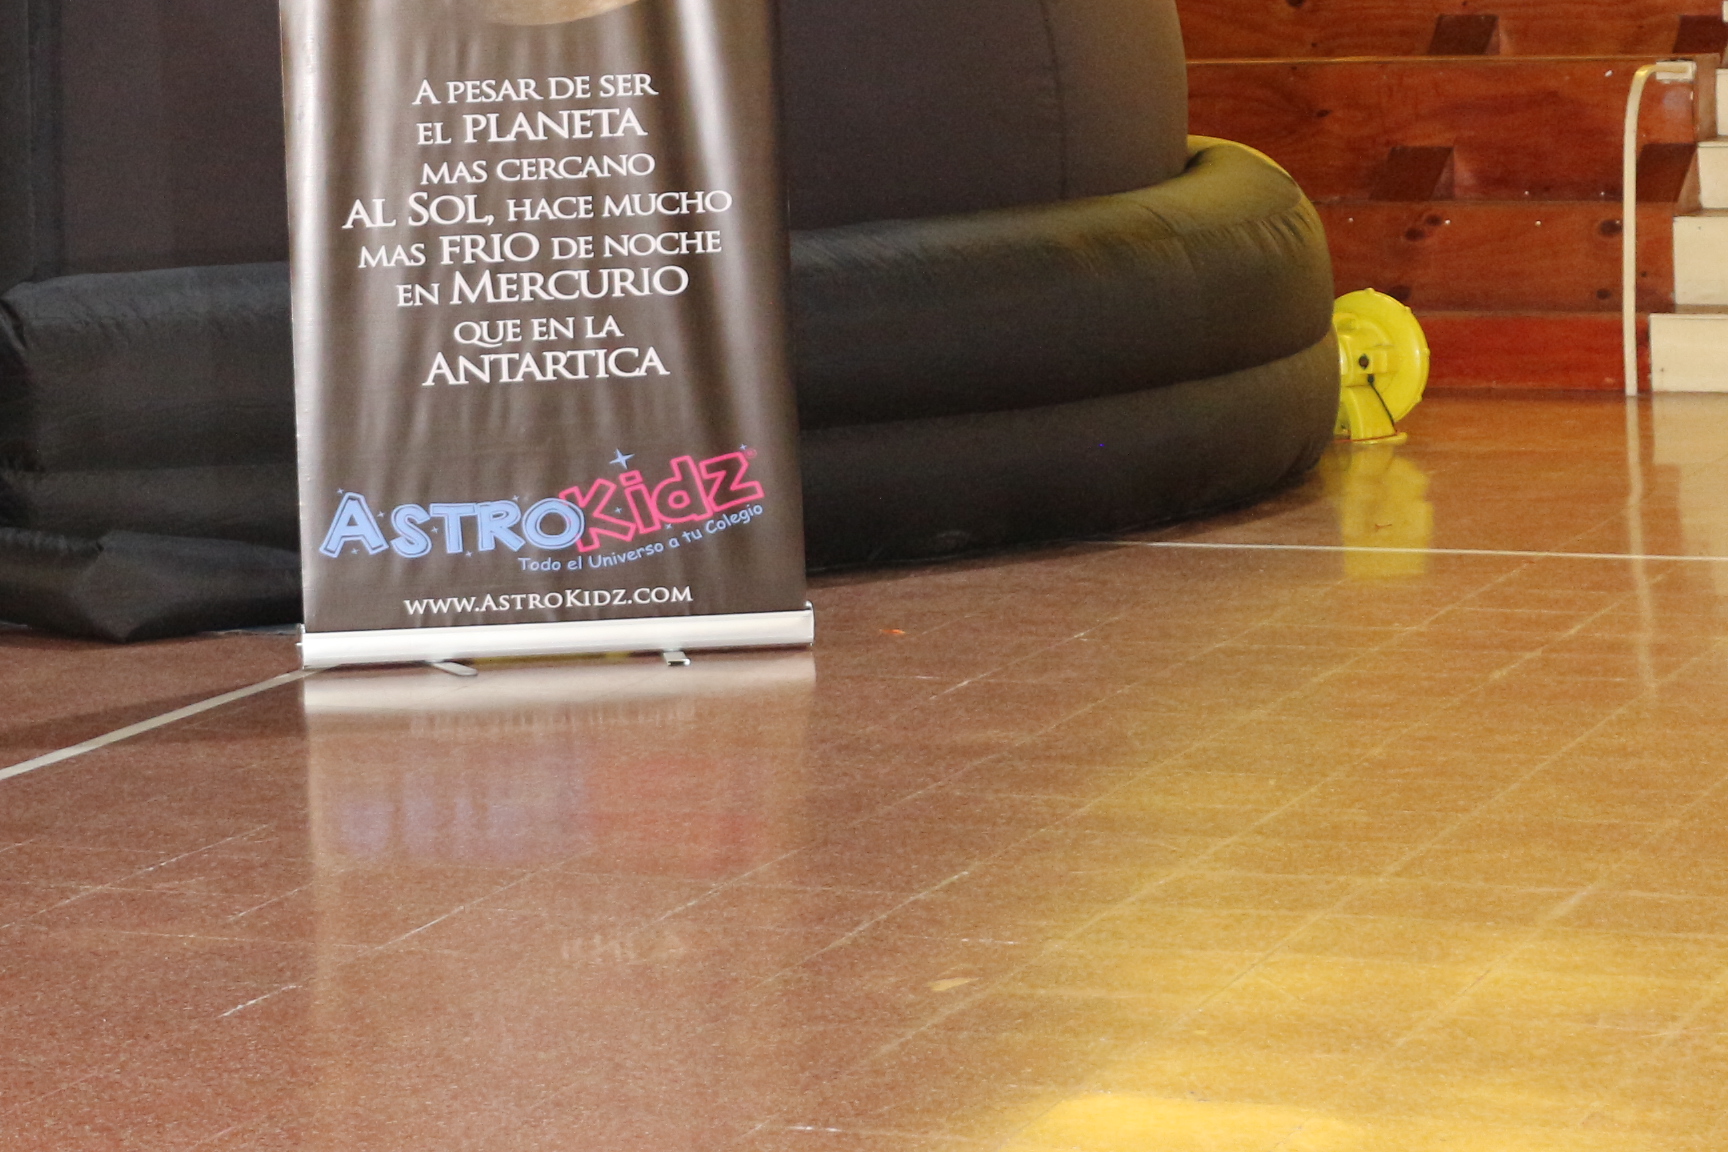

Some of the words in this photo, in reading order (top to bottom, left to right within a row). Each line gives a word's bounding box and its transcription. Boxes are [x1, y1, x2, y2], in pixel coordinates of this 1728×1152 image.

[412, 79, 440, 106] A
[447, 78, 542, 103] PESAR
[548, 74, 591, 99] DE
[599, 73, 658, 97] SER
[416, 121, 452, 145] EL
[463, 107, 648, 144] PLANETA
[420, 160, 487, 185] MAS
[496, 153, 655, 183] CERCANO
[342, 198, 396, 230] AL
[407, 191, 495, 226] SOL,
[506, 195, 594, 223] HACE
[602, 189, 733, 217] MUCHO
[358, 243, 426, 269] MAS
[439, 232, 540, 265] FRIO
[551, 236, 594, 261] DE
[603, 230, 722, 258] NOCHE
[397, 282, 440, 308] EN
[450, 265, 690, 305] MERCURIO
[453, 320, 523, 347] QUE
[532, 317, 574, 340] EN
[585, 314, 624, 338] LA
[422, 346, 670, 386] ANTARTICA
[518, 557, 561, 571] Todo
[567, 555, 583, 570] el
[589, 542, 664, 568] Universo
[668, 538, 680, 549] a
[682, 528, 703, 544] tu
[705, 504, 764, 534] Colegio
